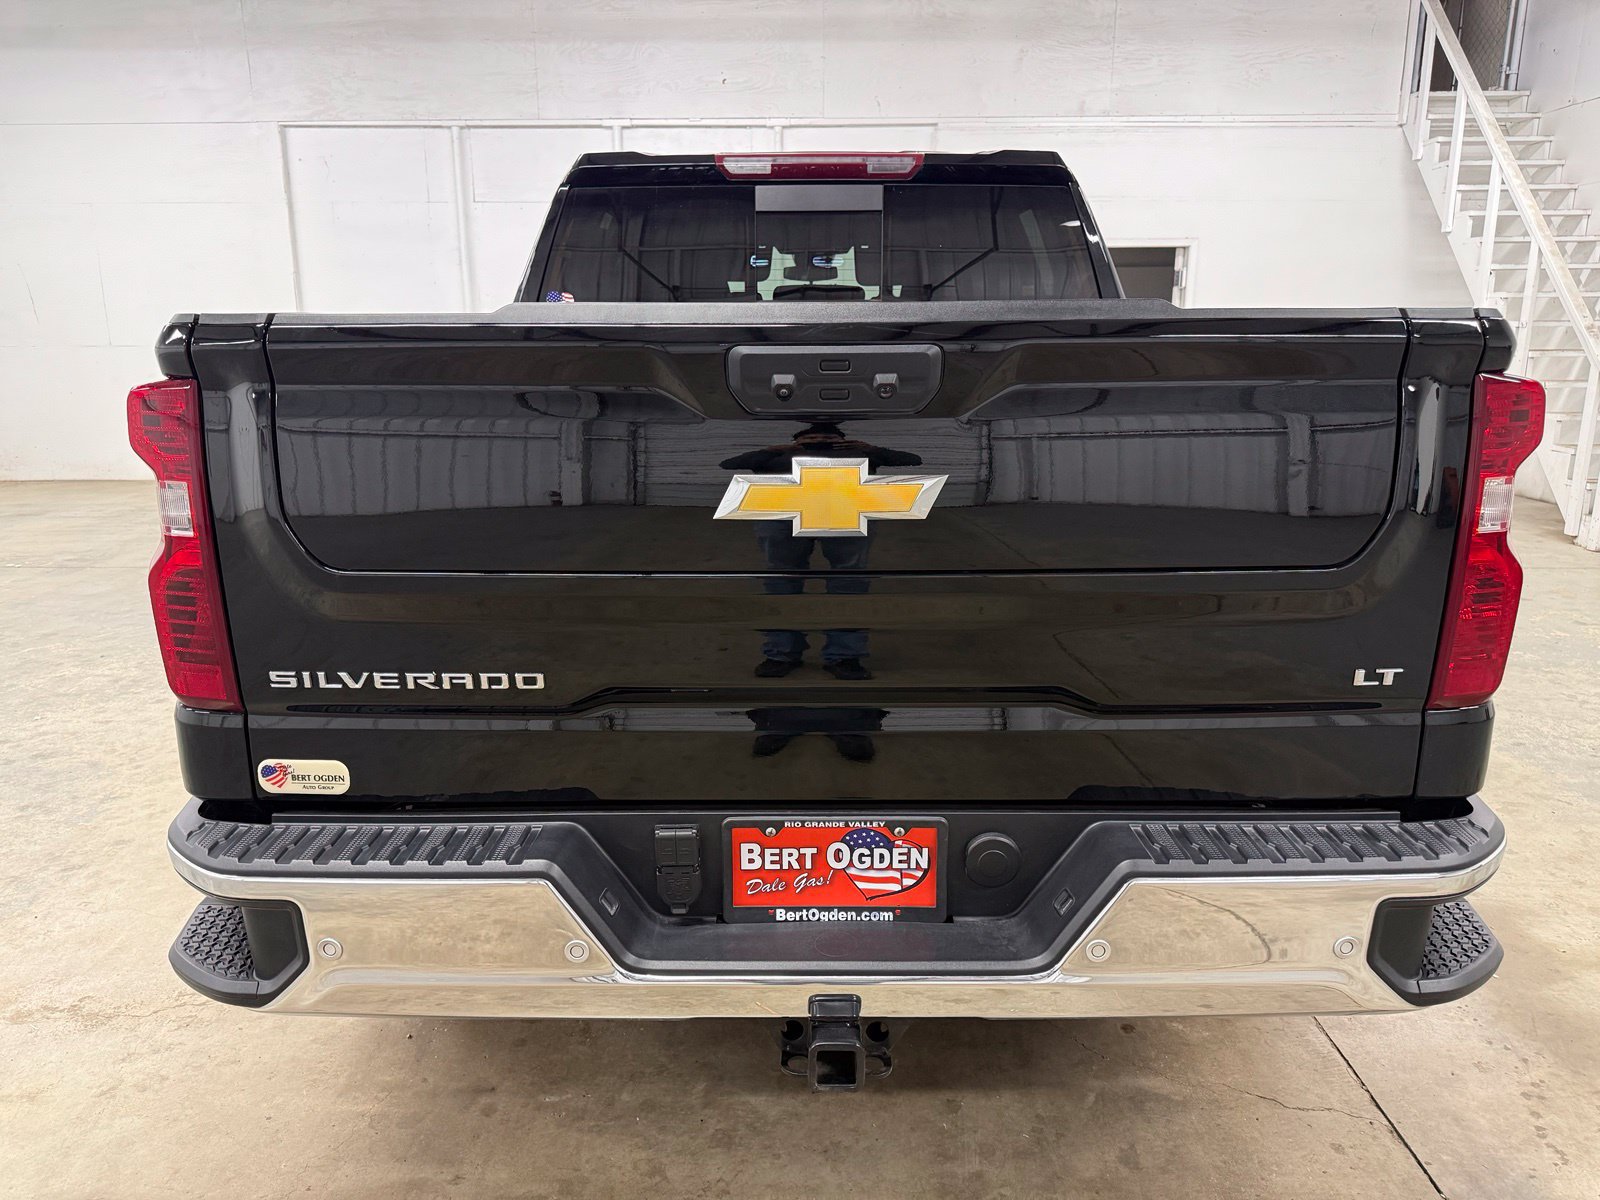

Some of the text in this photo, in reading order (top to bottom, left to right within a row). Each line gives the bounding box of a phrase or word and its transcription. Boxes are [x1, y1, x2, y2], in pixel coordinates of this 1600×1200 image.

[269, 671, 545, 689] SILVERADO
[1353, 668, 1404, 686] LT
[291, 774, 345, 783] BERT OGDEN
[740, 841, 929, 871] BERT OGDEN
[746, 870, 834, 895] Dale Gas!
[775, 909, 894, 921] BertOgden.com
